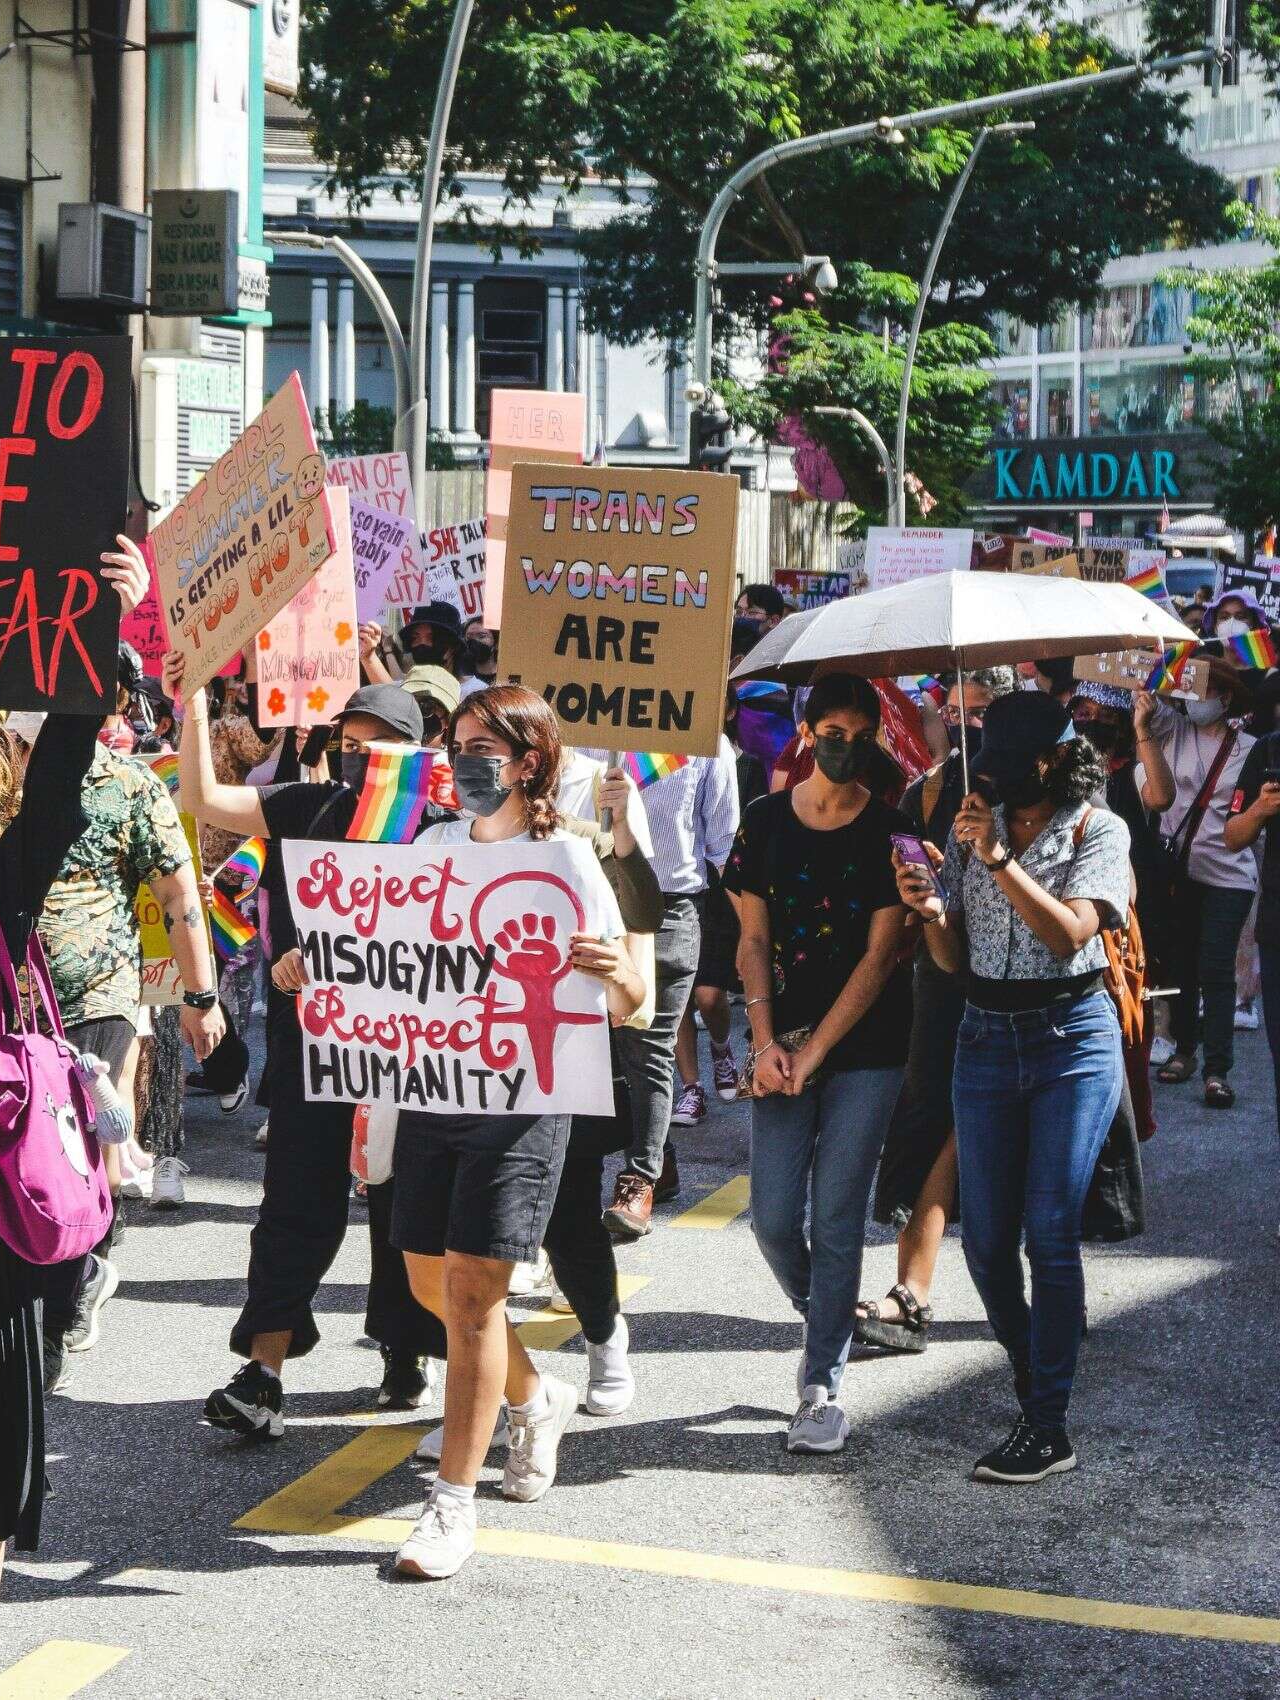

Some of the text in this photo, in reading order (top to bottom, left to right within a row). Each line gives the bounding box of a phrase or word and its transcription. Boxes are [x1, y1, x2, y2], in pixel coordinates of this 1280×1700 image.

[11, 349, 105, 440] TO
[508, 406, 564, 442] HER
[154, 410, 286, 565] HOT GIRL
[373, 454, 403, 488] OF
[995, 447, 1181, 500] KAMDAR
[176, 443, 293, 588] SUMMER
[370, 515, 405, 548] vain
[530, 485, 700, 536] TRANS
[901, 530, 945, 540] REMINDER
[170, 598, 185, 626] IS
[188, 536, 247, 605] GETTING
[251, 522, 262, 547] A
[268, 493, 294, 530] LIL
[308, 541, 326, 562] NOW
[429, 525, 461, 562] SHE
[182, 577, 240, 650] TOO
[247, 502, 315, 598] HOT
[521, 556, 709, 609] WOMEN
[555, 613, 660, 665] ARE
[296, 851, 474, 943] Reject
[297, 927, 497, 1005] MISOGYNY
[303, 981, 520, 1072] Respect
[308, 1043, 527, 1112] HUMANITY
